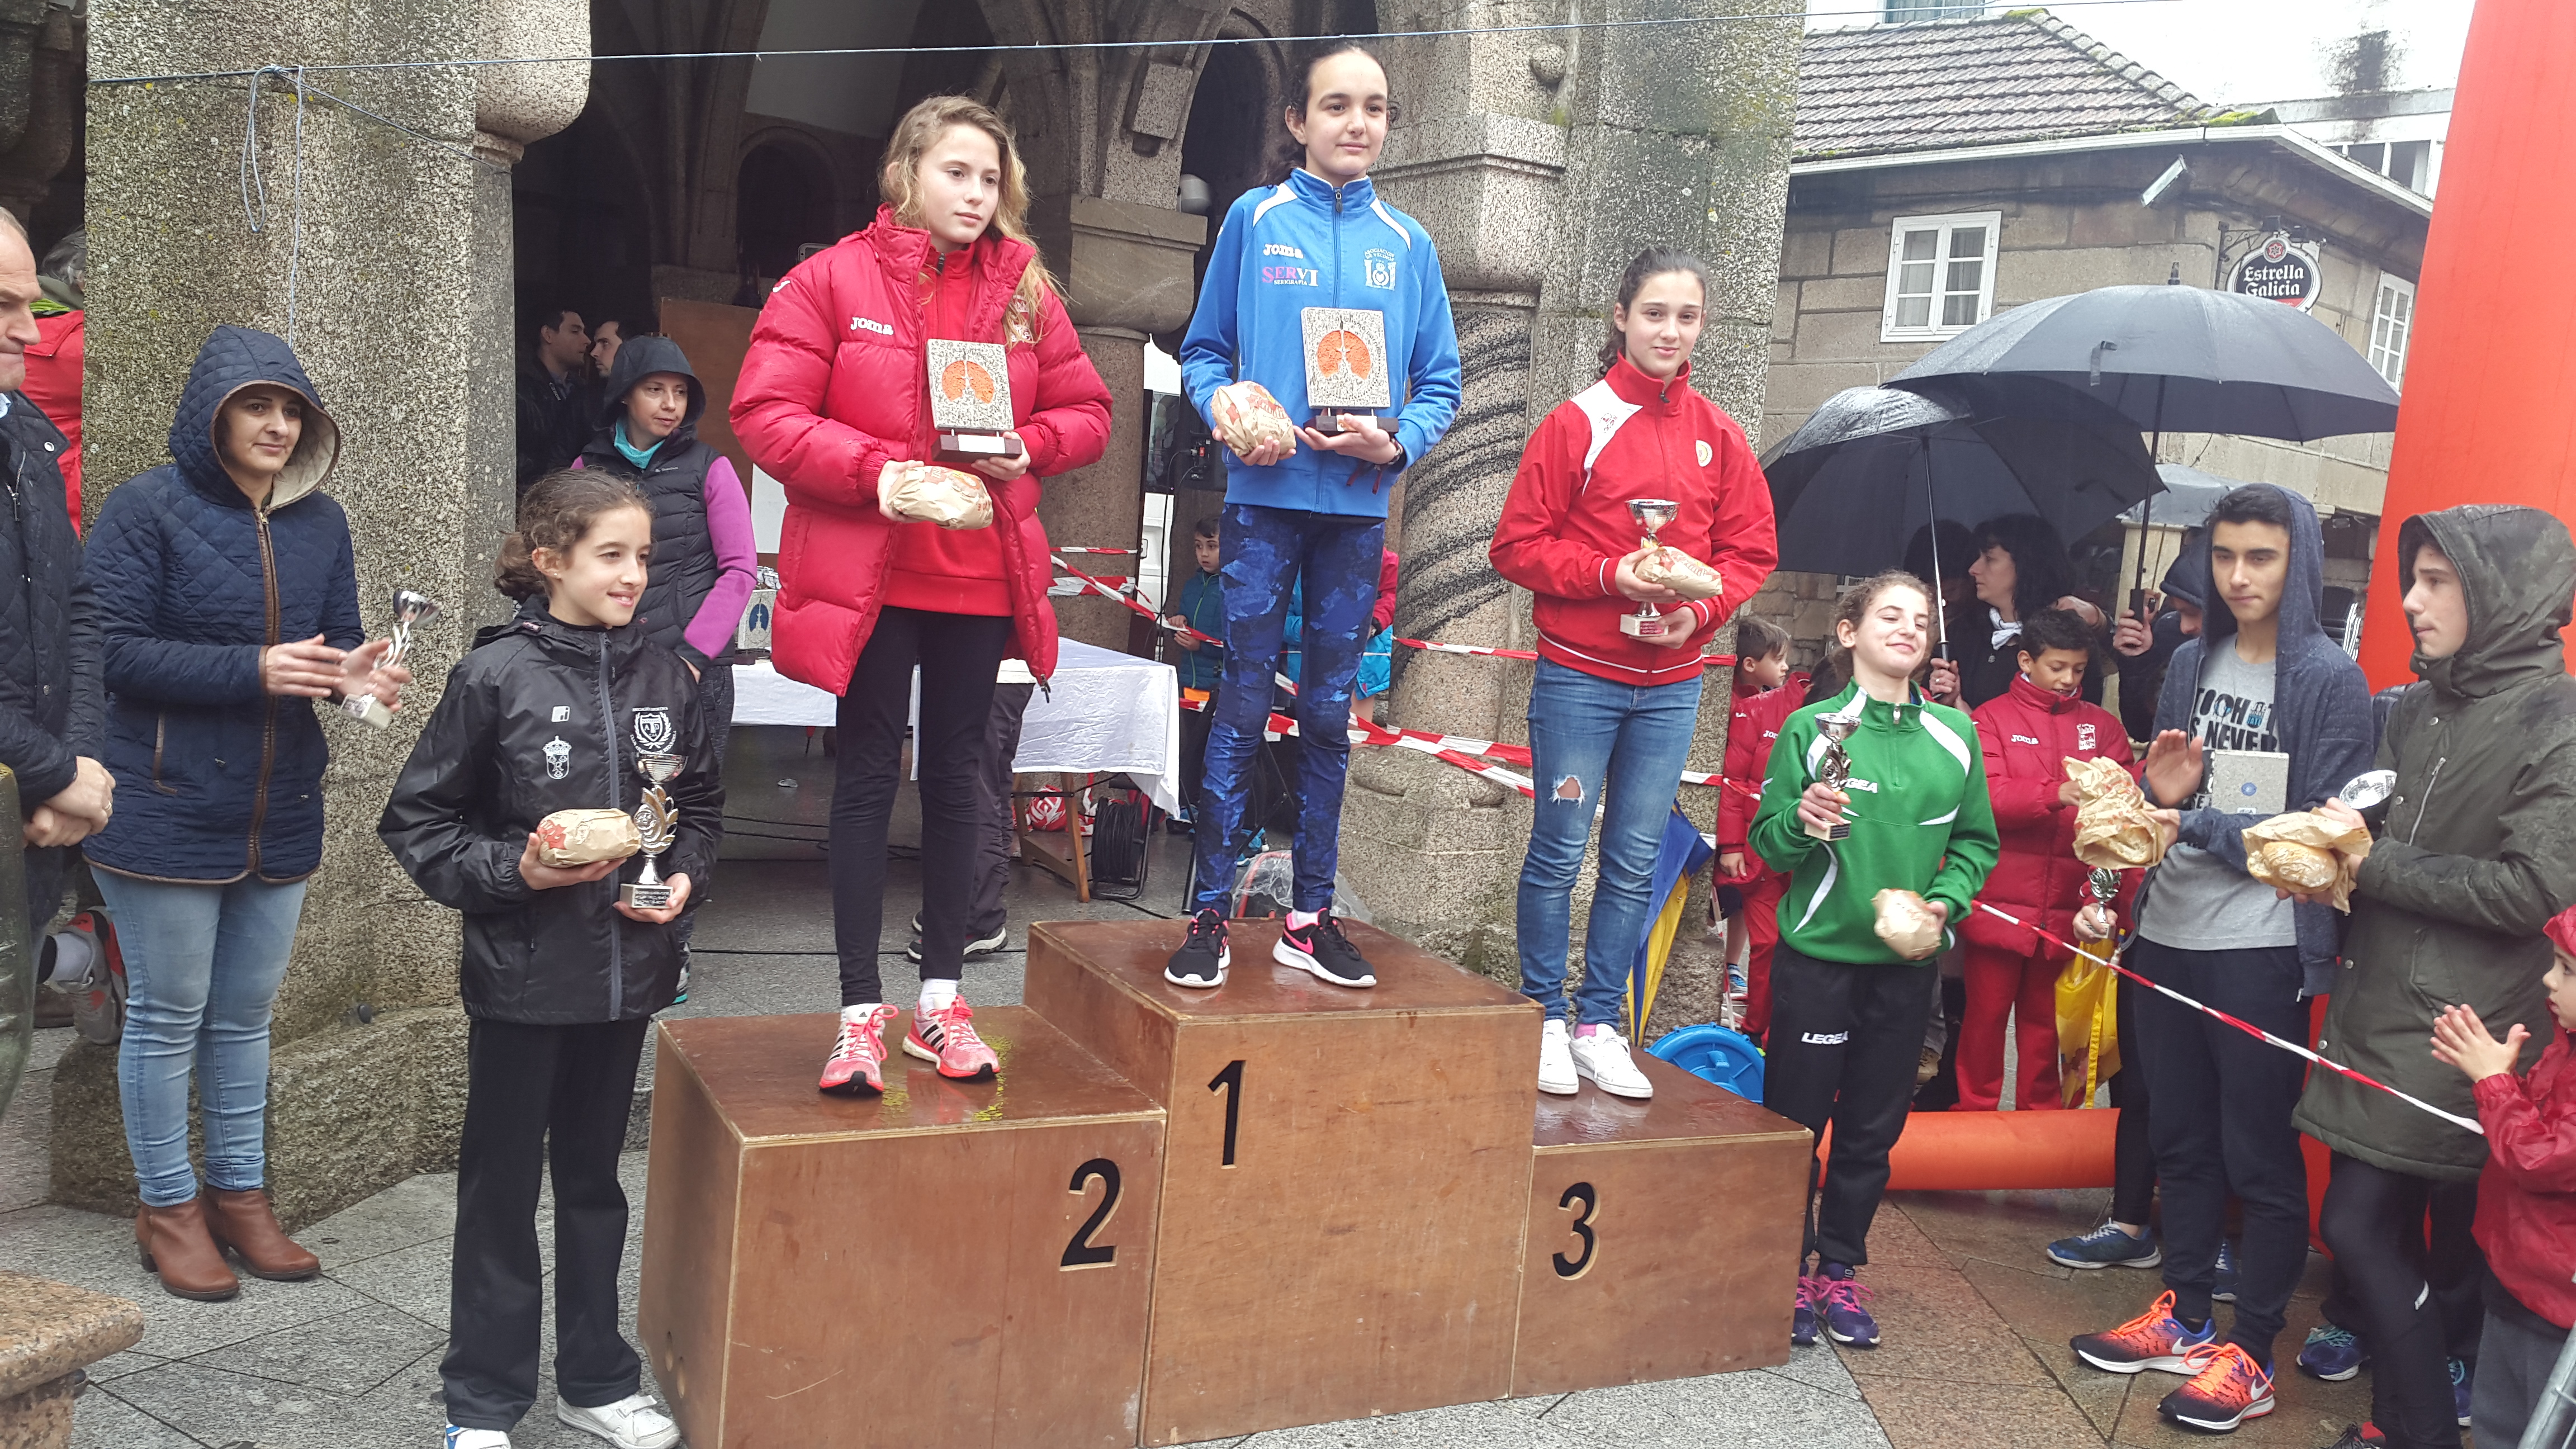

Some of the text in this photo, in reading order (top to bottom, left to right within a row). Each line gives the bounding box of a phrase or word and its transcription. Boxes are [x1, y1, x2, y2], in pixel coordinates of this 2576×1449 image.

[1262, 267, 1319, 287] SERVI
[2243, 264, 2304, 282] Estrella
[2246, 280, 2300, 297] Galicia
[1208, 1060, 1246, 1168] 1
[1060, 1158, 1123, 1271] 2
[1552, 1182, 1600, 1280] 3
